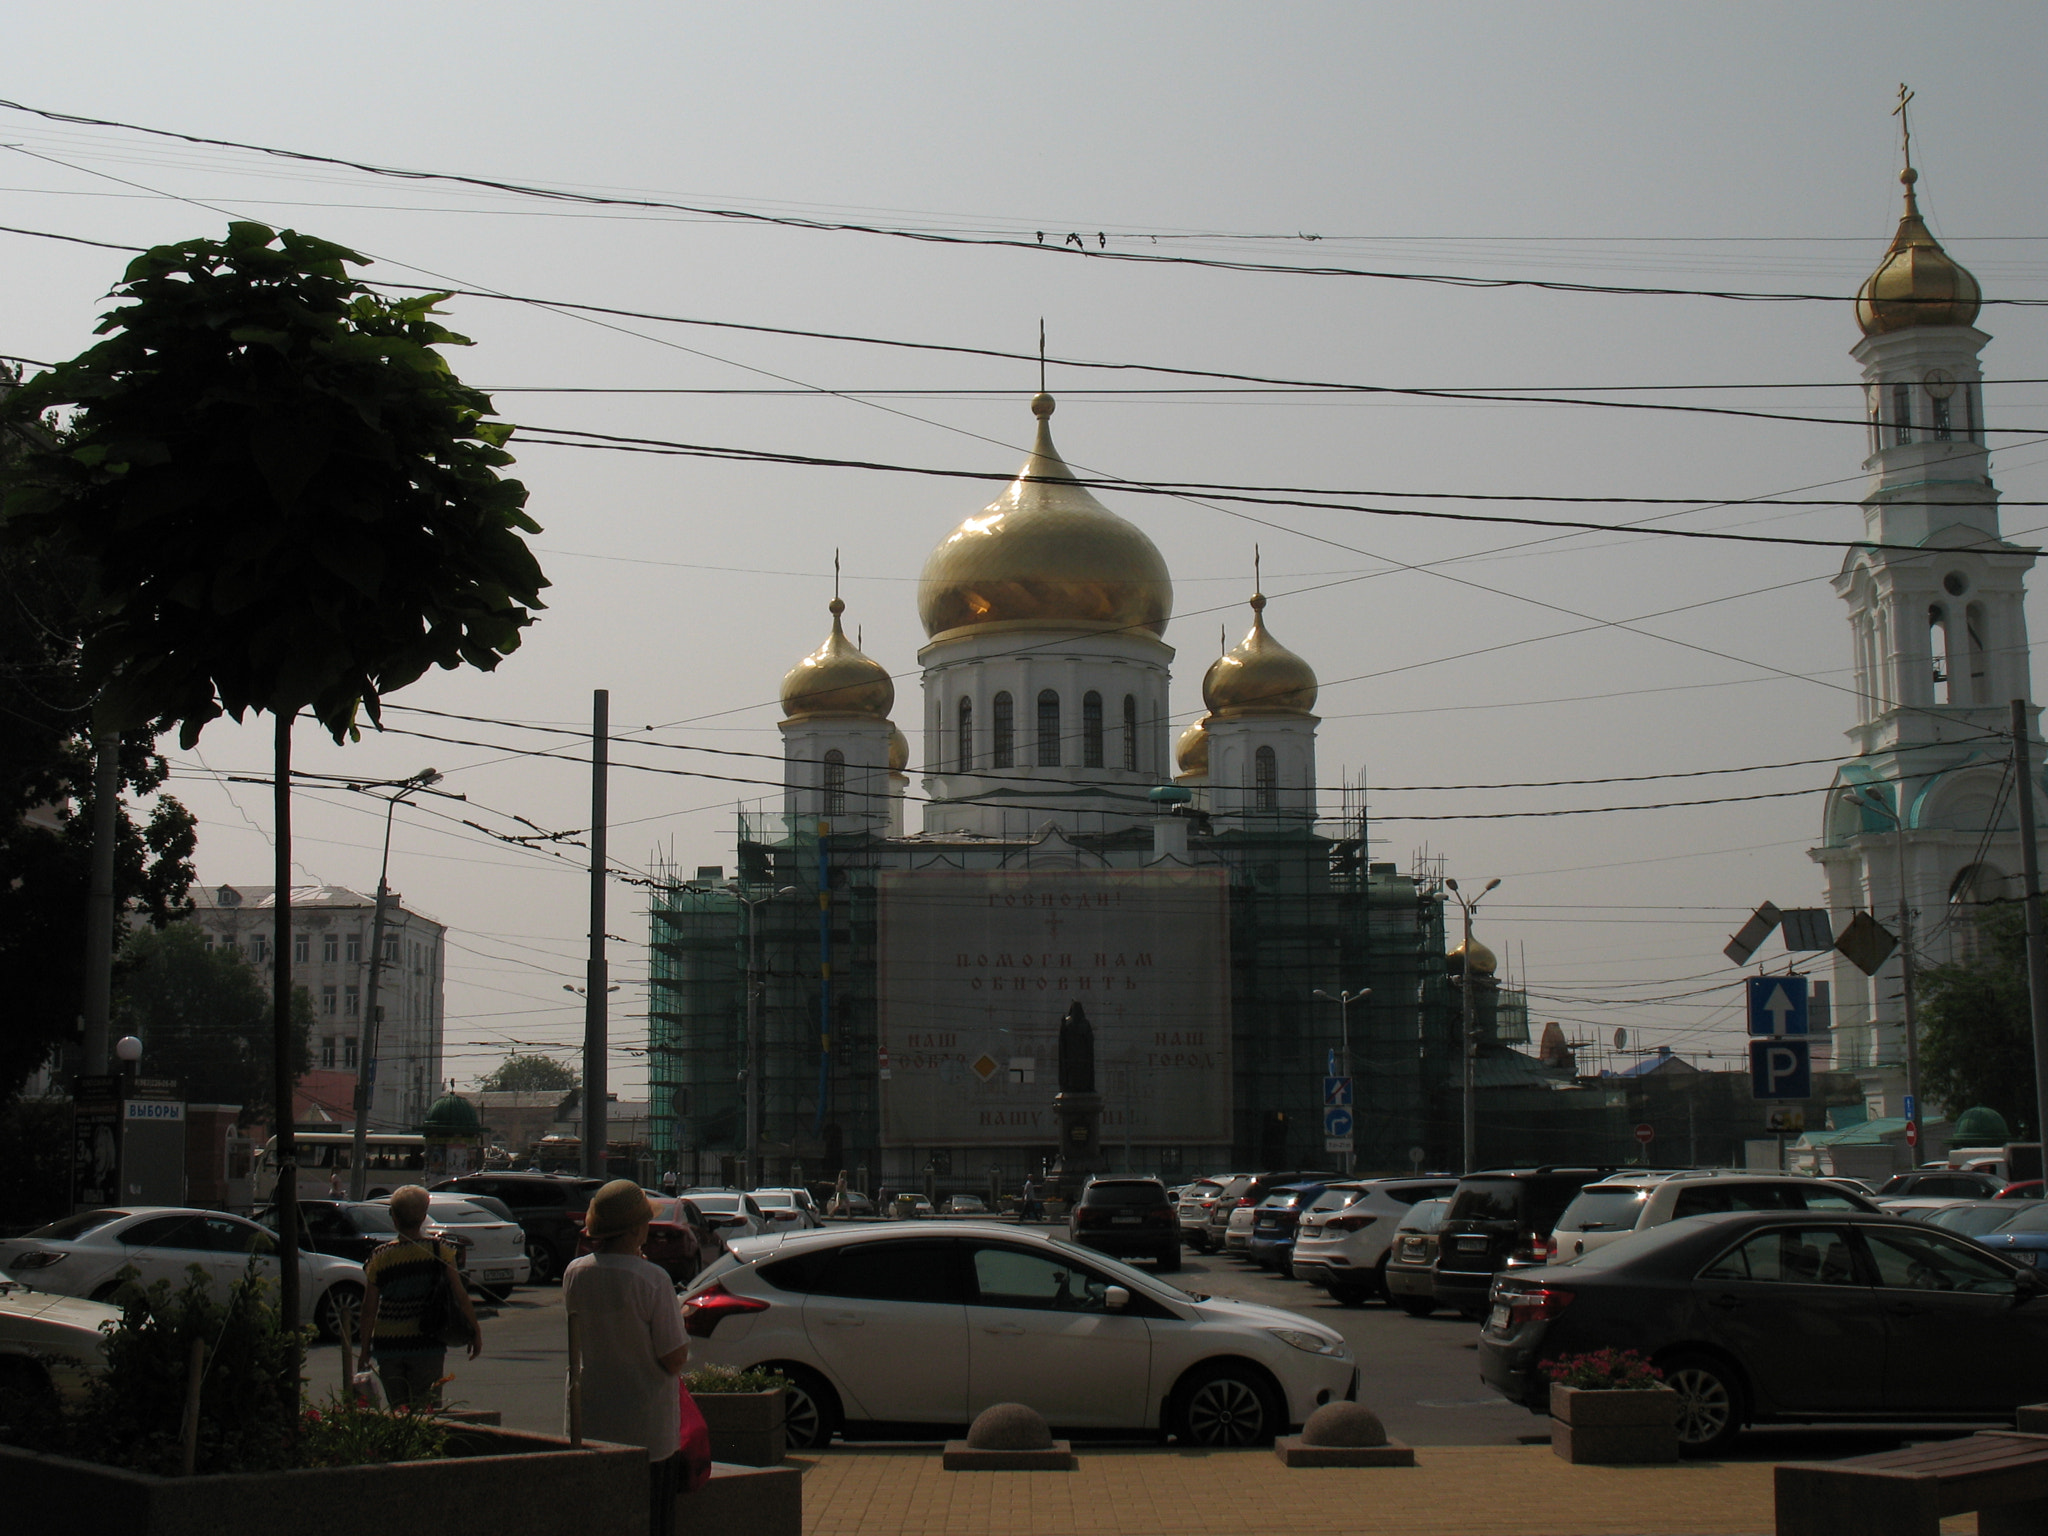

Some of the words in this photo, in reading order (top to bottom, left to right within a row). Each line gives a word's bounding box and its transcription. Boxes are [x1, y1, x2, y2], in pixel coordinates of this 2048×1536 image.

[989, 891, 1121, 909] ГОСПОДИ!
[956, 952, 1072, 968] ПОМОГИ
[1094, 952, 1152, 967] НАМ
[971, 976, 1137, 990] ОБНОВИТЬ
[908, 1033, 957, 1048] НАШ
[1155, 1031, 1204, 1046] НАШ
[1147, 1053, 1215, 1070] ГОРОД
[1767, 1047, 1798, 1094] P
[129, 1104, 179, 1118] ВЫБОРЫ
[979, 1111, 1043, 1128] НАШУ
